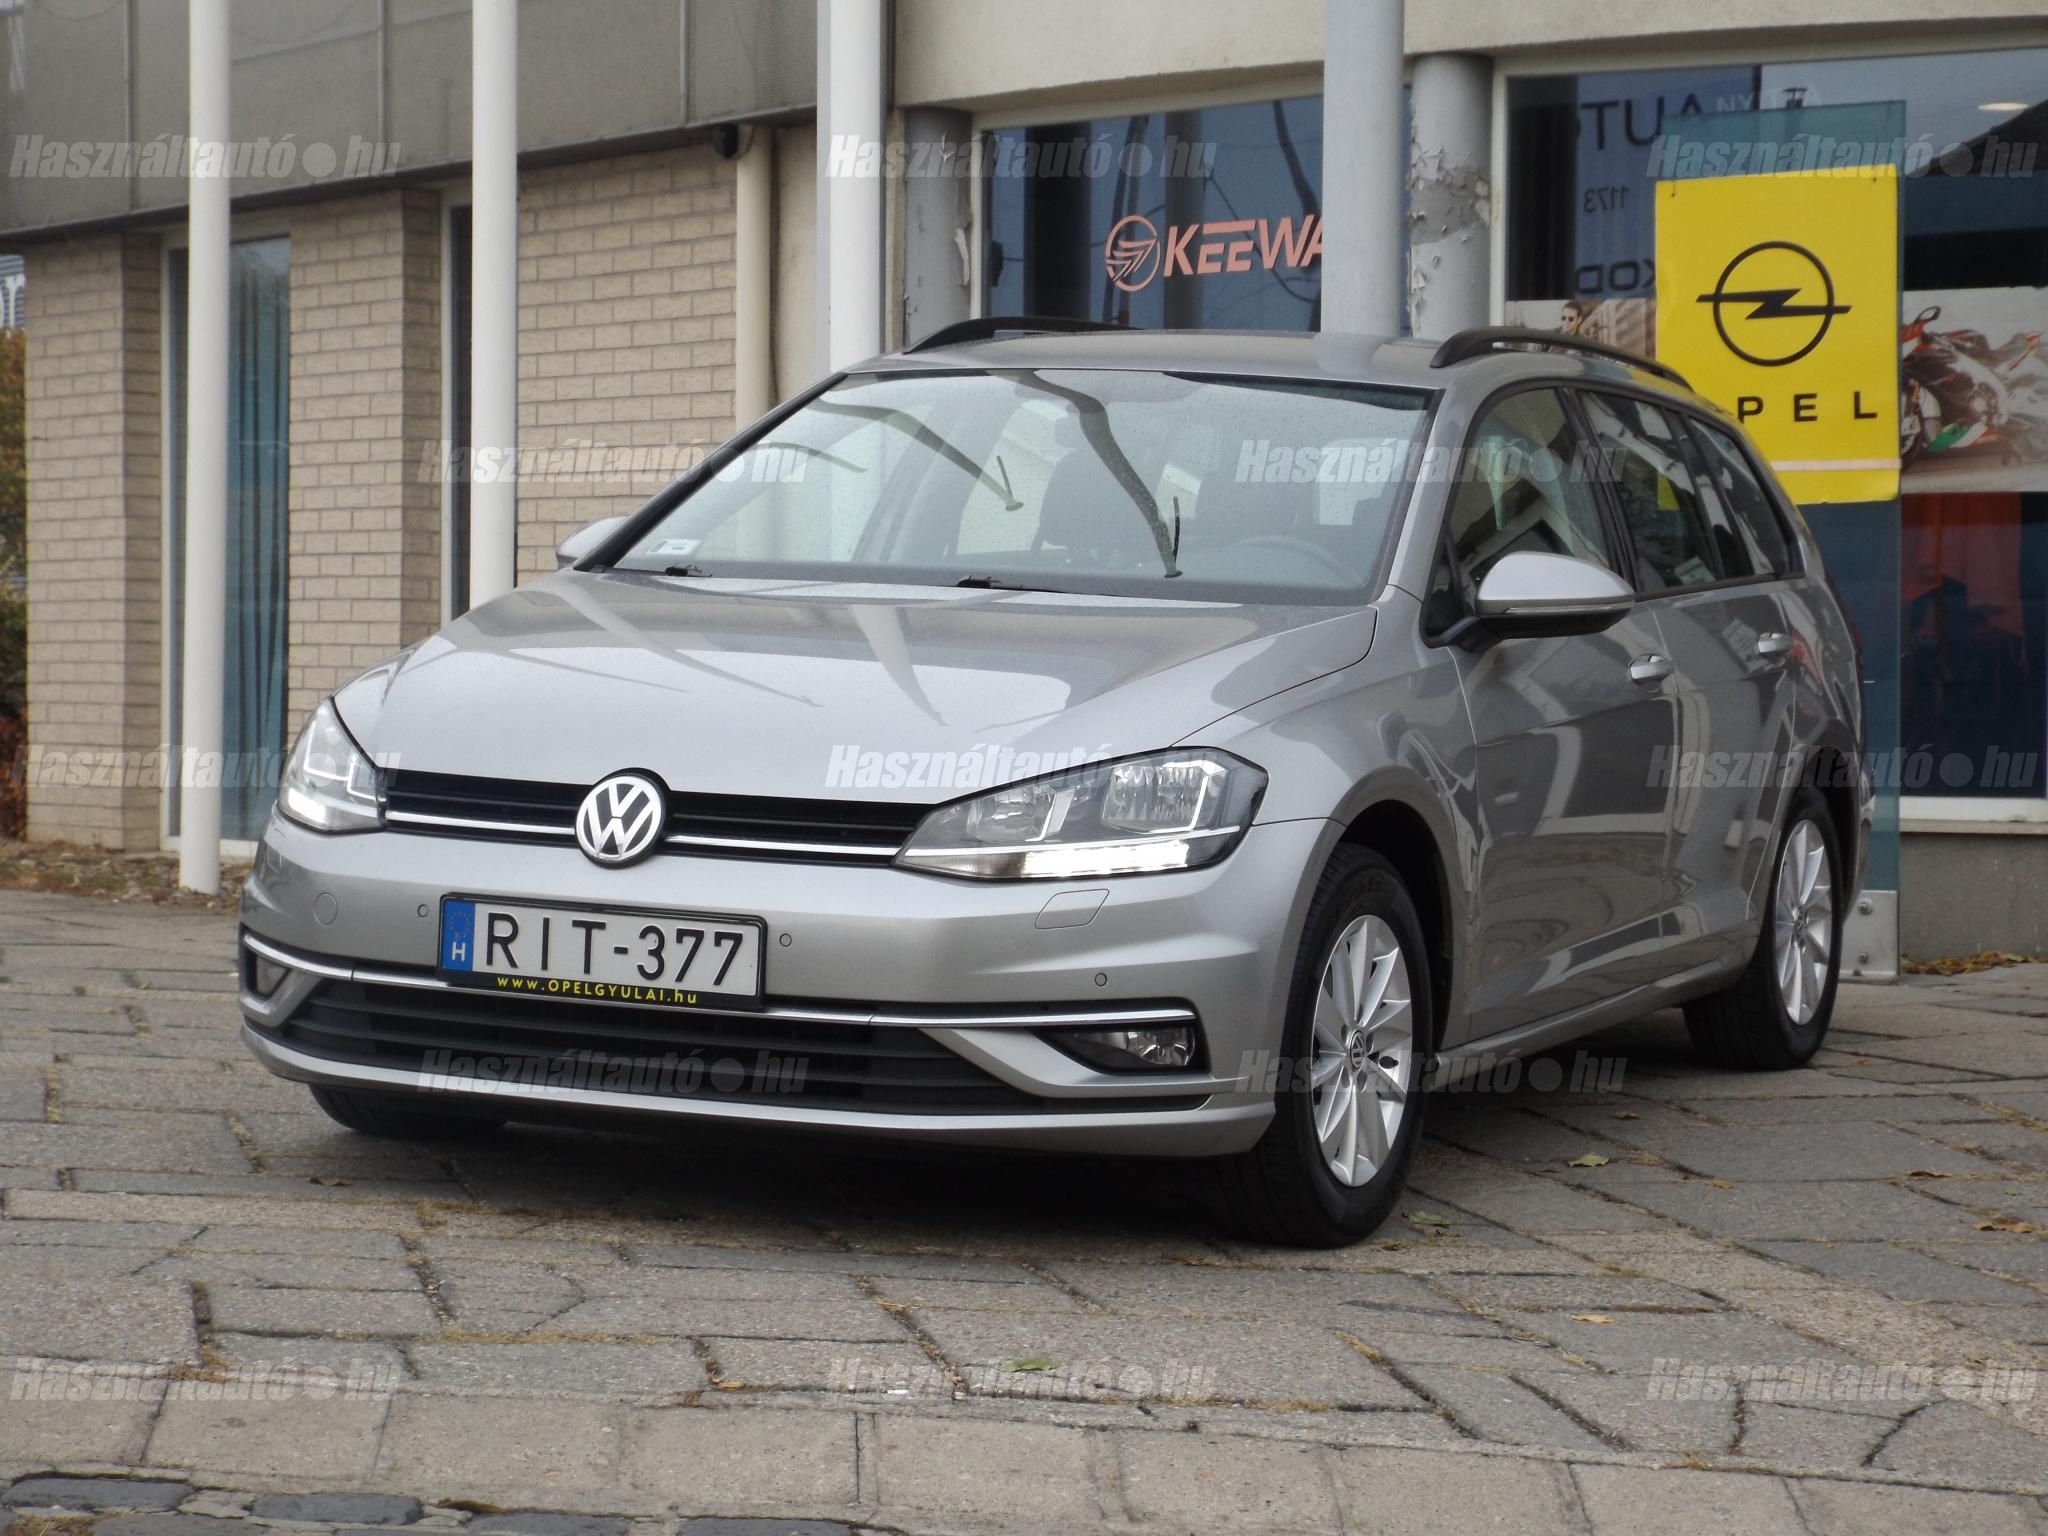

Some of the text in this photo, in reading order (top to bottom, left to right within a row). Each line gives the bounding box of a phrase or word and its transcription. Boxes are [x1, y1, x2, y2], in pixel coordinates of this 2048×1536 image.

[1737, 391, 1878, 424] PEL
[452, 942, 467, 962] H
[486, 912, 743, 986] RIT-377
[496, 976, 698, 1005] www.OPELGYULAI.hu
